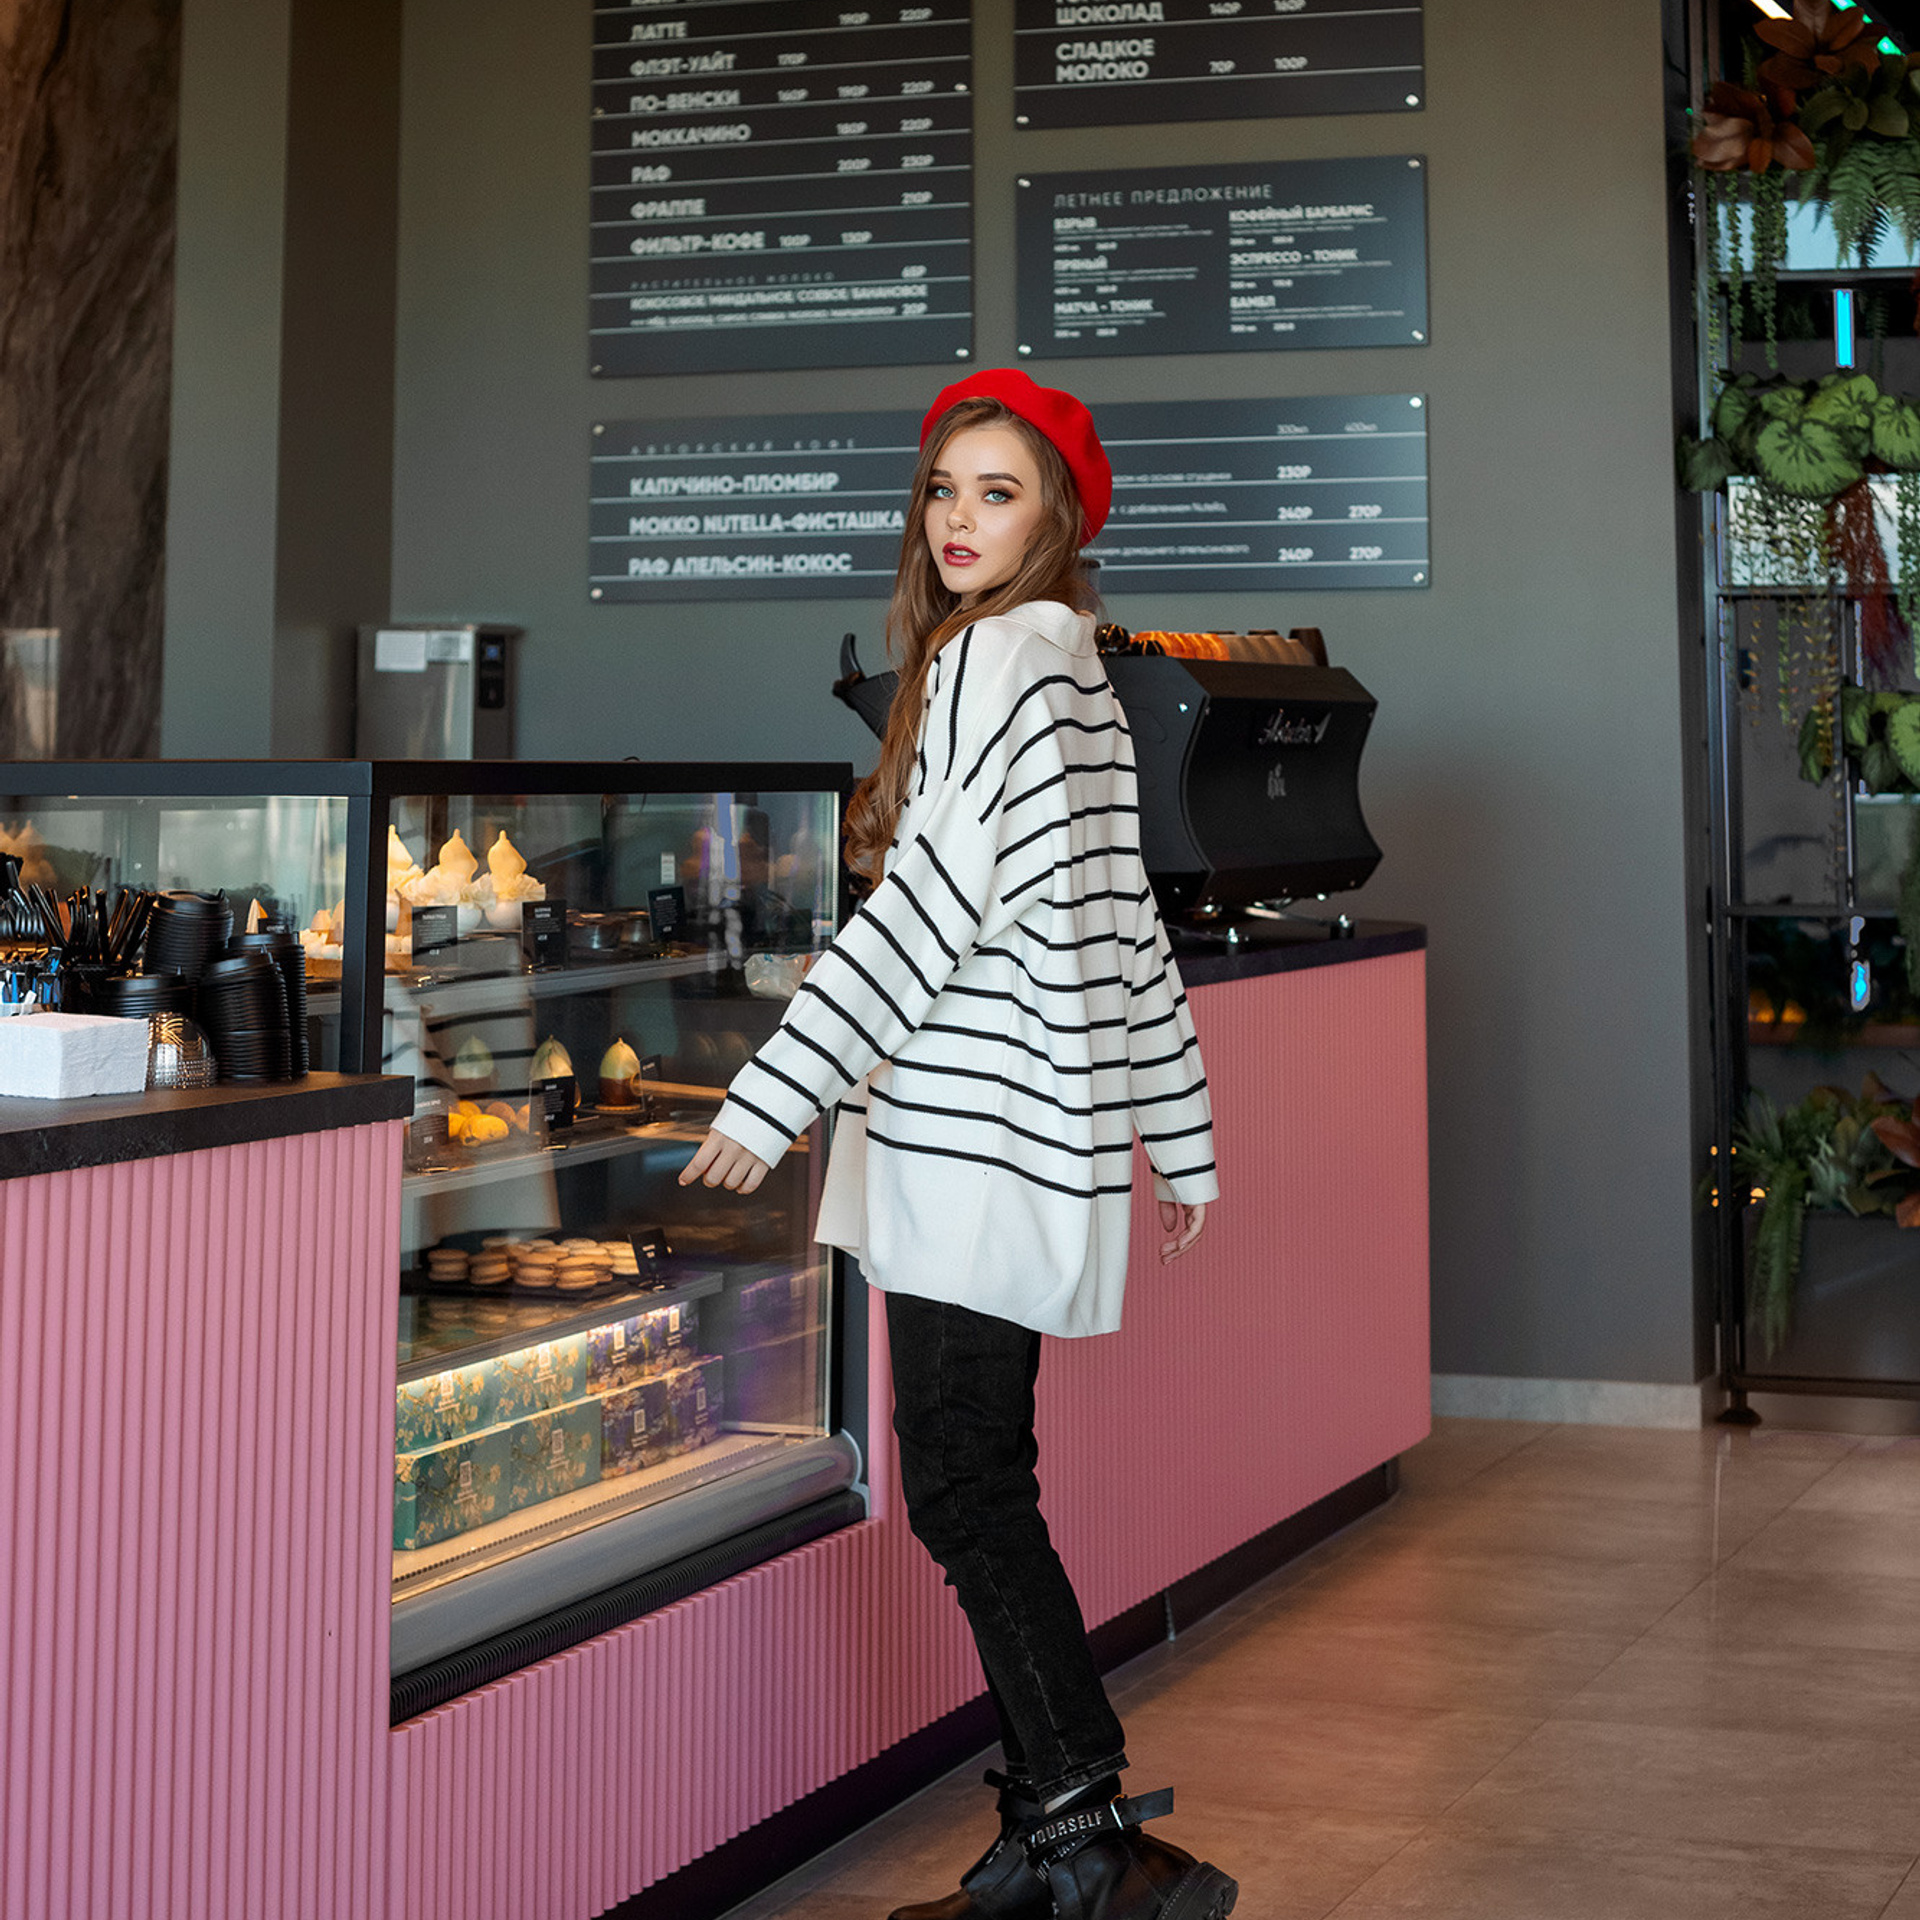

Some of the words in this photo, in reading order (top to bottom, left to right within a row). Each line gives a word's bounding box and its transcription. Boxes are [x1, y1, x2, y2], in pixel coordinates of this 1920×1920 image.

[1056, 3, 1164, 24] ШОКОЛАД
[630, 21, 687, 41] ЛАТТЕ
[1056, 39, 1155, 60] СЛАДКОЕ
[630, 51, 737, 76] ФЛЭТ-УАЙТ
[1056, 61, 1149, 82] МОЛОКО
[630, 90, 740, 112] ПО-ВЕНСКИ
[631, 123, 752, 147] МОККАЧИНО
[631, 165, 672, 183] РАФ
[1054, 192, 1124, 208] ЛЕТНЕЕ
[1131, 183, 1272, 204] ПРЕДЛОЖЕНИЕ
[630, 198, 706, 219] ФРАППЕ
[1229, 205, 1303, 222] КОФЕЙНЫЙ
[1304, 203, 1374, 219] БАРБАРИС
[630, 231, 765, 255] ФИЛЬТР-КОФЕ
[1229, 251, 1302, 266] ЭСПРЕССО
[1313, 249, 1358, 263] ТОНИК
[630, 294, 705, 311] КОКОСОВОЕ
[797, 287, 849, 303] СОЕВОЕ
[850, 284, 928, 300] БАНАНОВОЕ
[1110, 299, 1153, 313] ТОНИК
[630, 472, 839, 496] КАПУЧИНО-ПЛОМБИР
[629, 515, 701, 535] МОККО
[703, 510, 906, 533] NUTELLA-ФИСТАШКА
[628, 557, 670, 576] РАФ
[672, 553, 853, 575] АПЕЛЬСИН-КОКОС
[1028, 1811, 1103, 1847] YOURSELF
